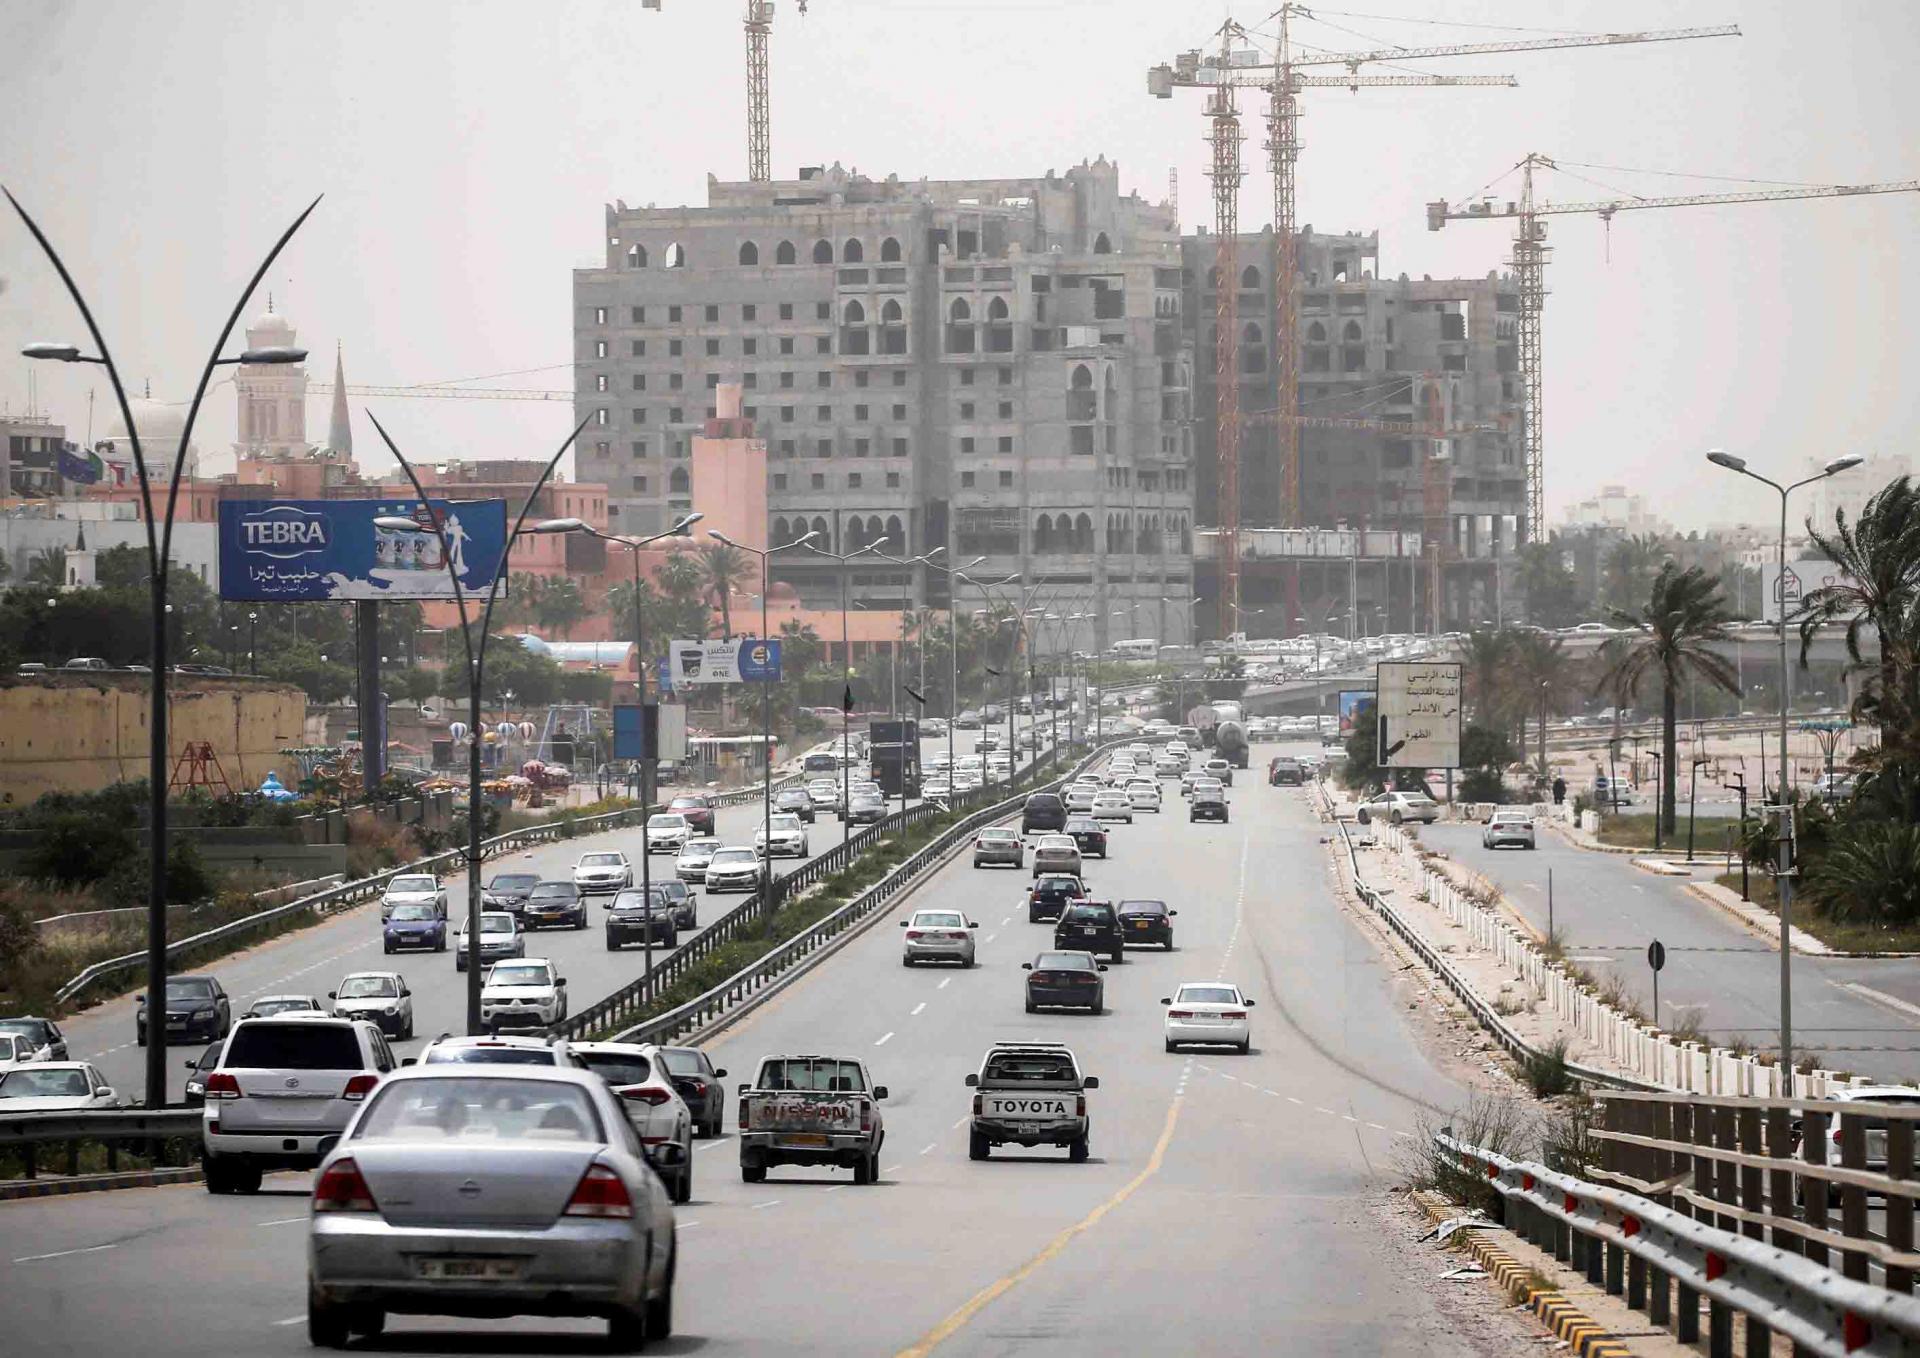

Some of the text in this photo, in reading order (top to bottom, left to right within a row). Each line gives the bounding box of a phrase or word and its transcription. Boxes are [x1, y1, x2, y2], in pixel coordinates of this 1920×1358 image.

[242, 521, 326, 544] TEBRA
[249, 565, 320, 584] حليب تبرا
[763, 1105, 849, 1120] NISSAN
[992, 1100, 1066, 1113] TOYOTA
